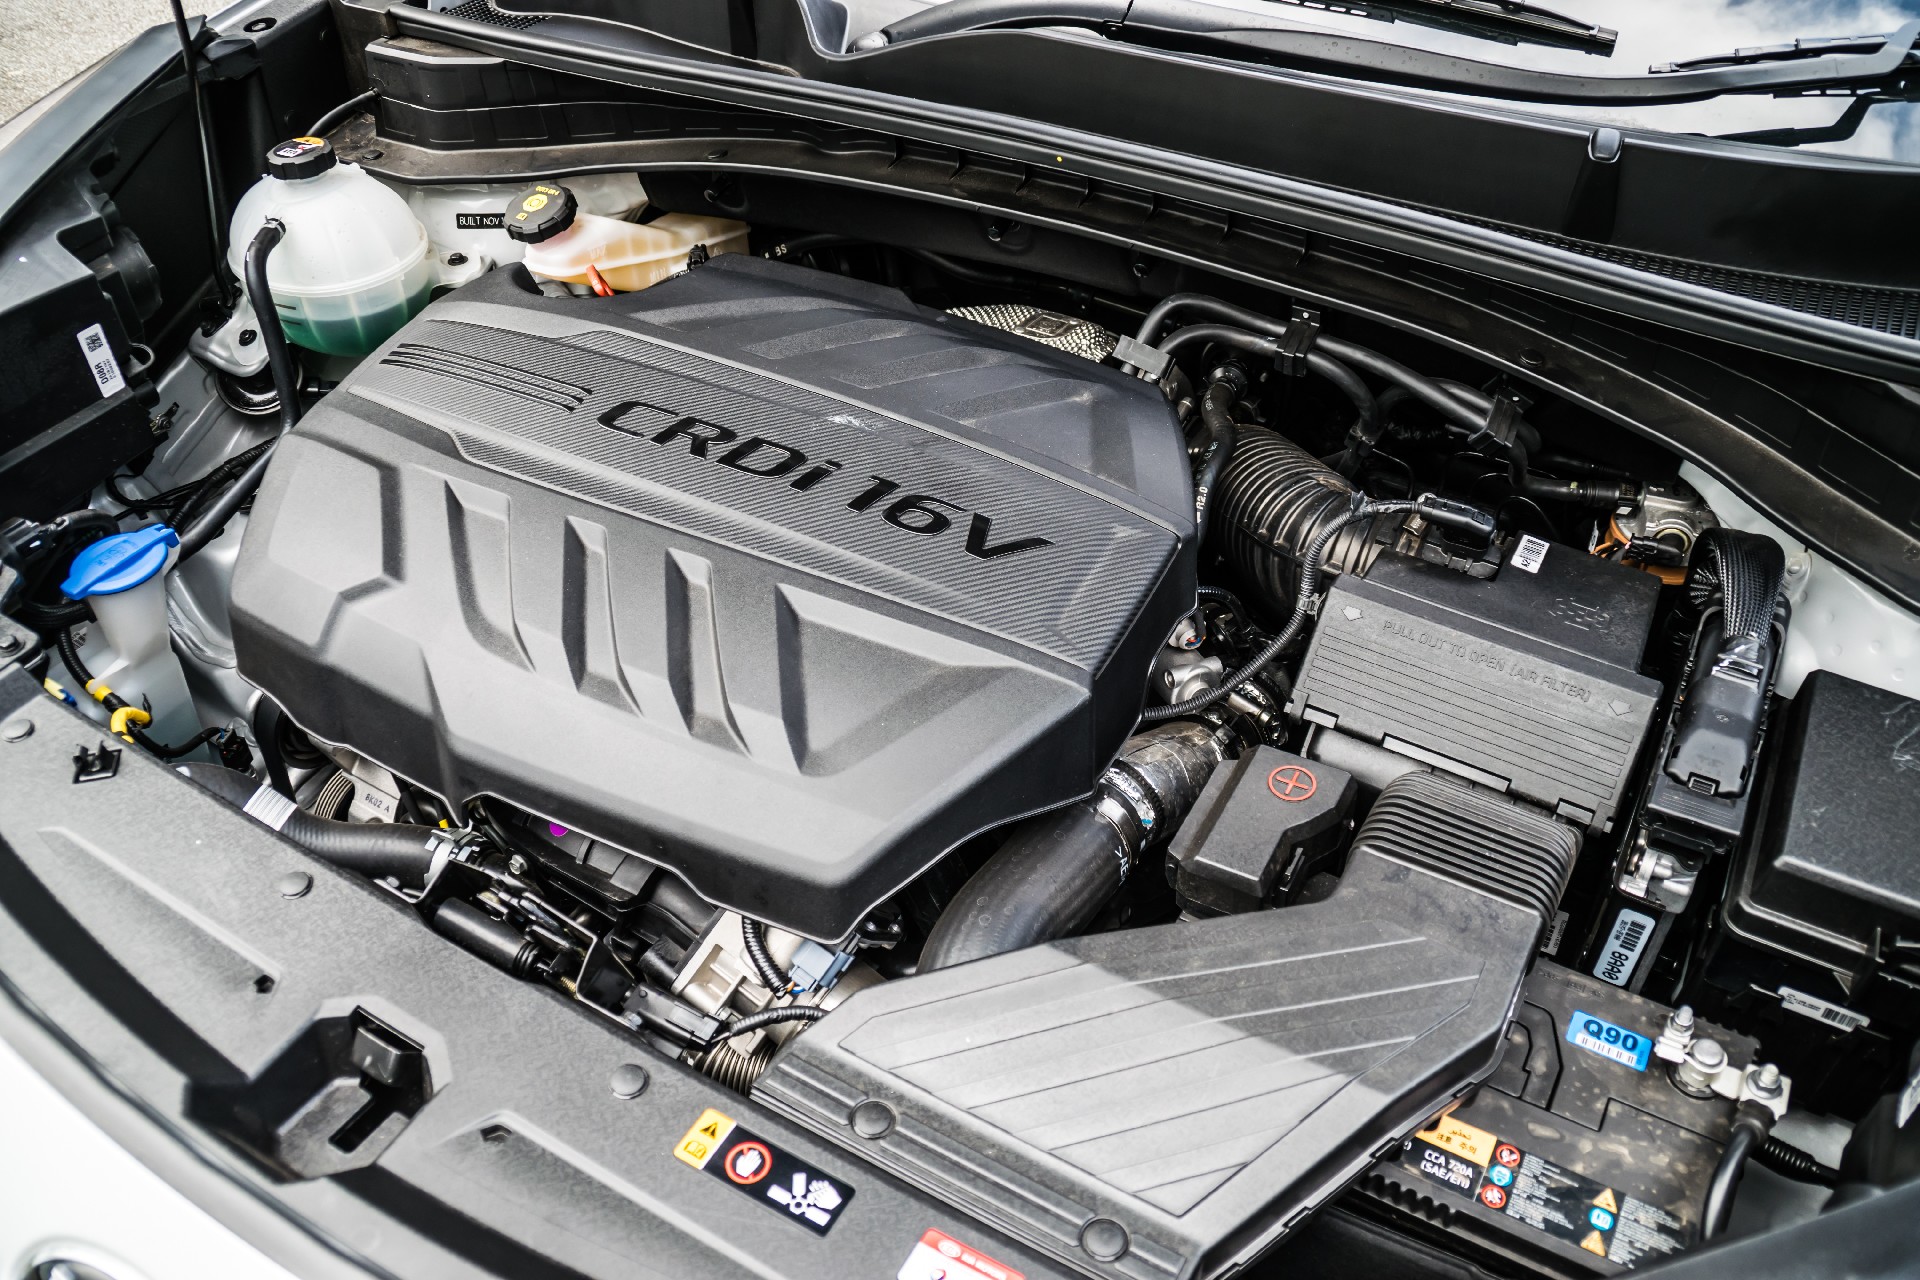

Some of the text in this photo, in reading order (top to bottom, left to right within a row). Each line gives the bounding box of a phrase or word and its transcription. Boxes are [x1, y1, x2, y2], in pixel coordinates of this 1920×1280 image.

[459, 216, 481, 226] BUILT
[483, 216, 500, 226] NOV
[597, 400, 1056, 561] CRDi 16V
[1383, 619, 1415, 642] PULL
[1418, 632, 1447, 650] OUT
[1449, 641, 1467, 659] TO
[1468, 650, 1506, 673] OPEN
[1583, 1019, 1639, 1052] Q90
[1424, 1149, 1473, 1179] CCA 720A
